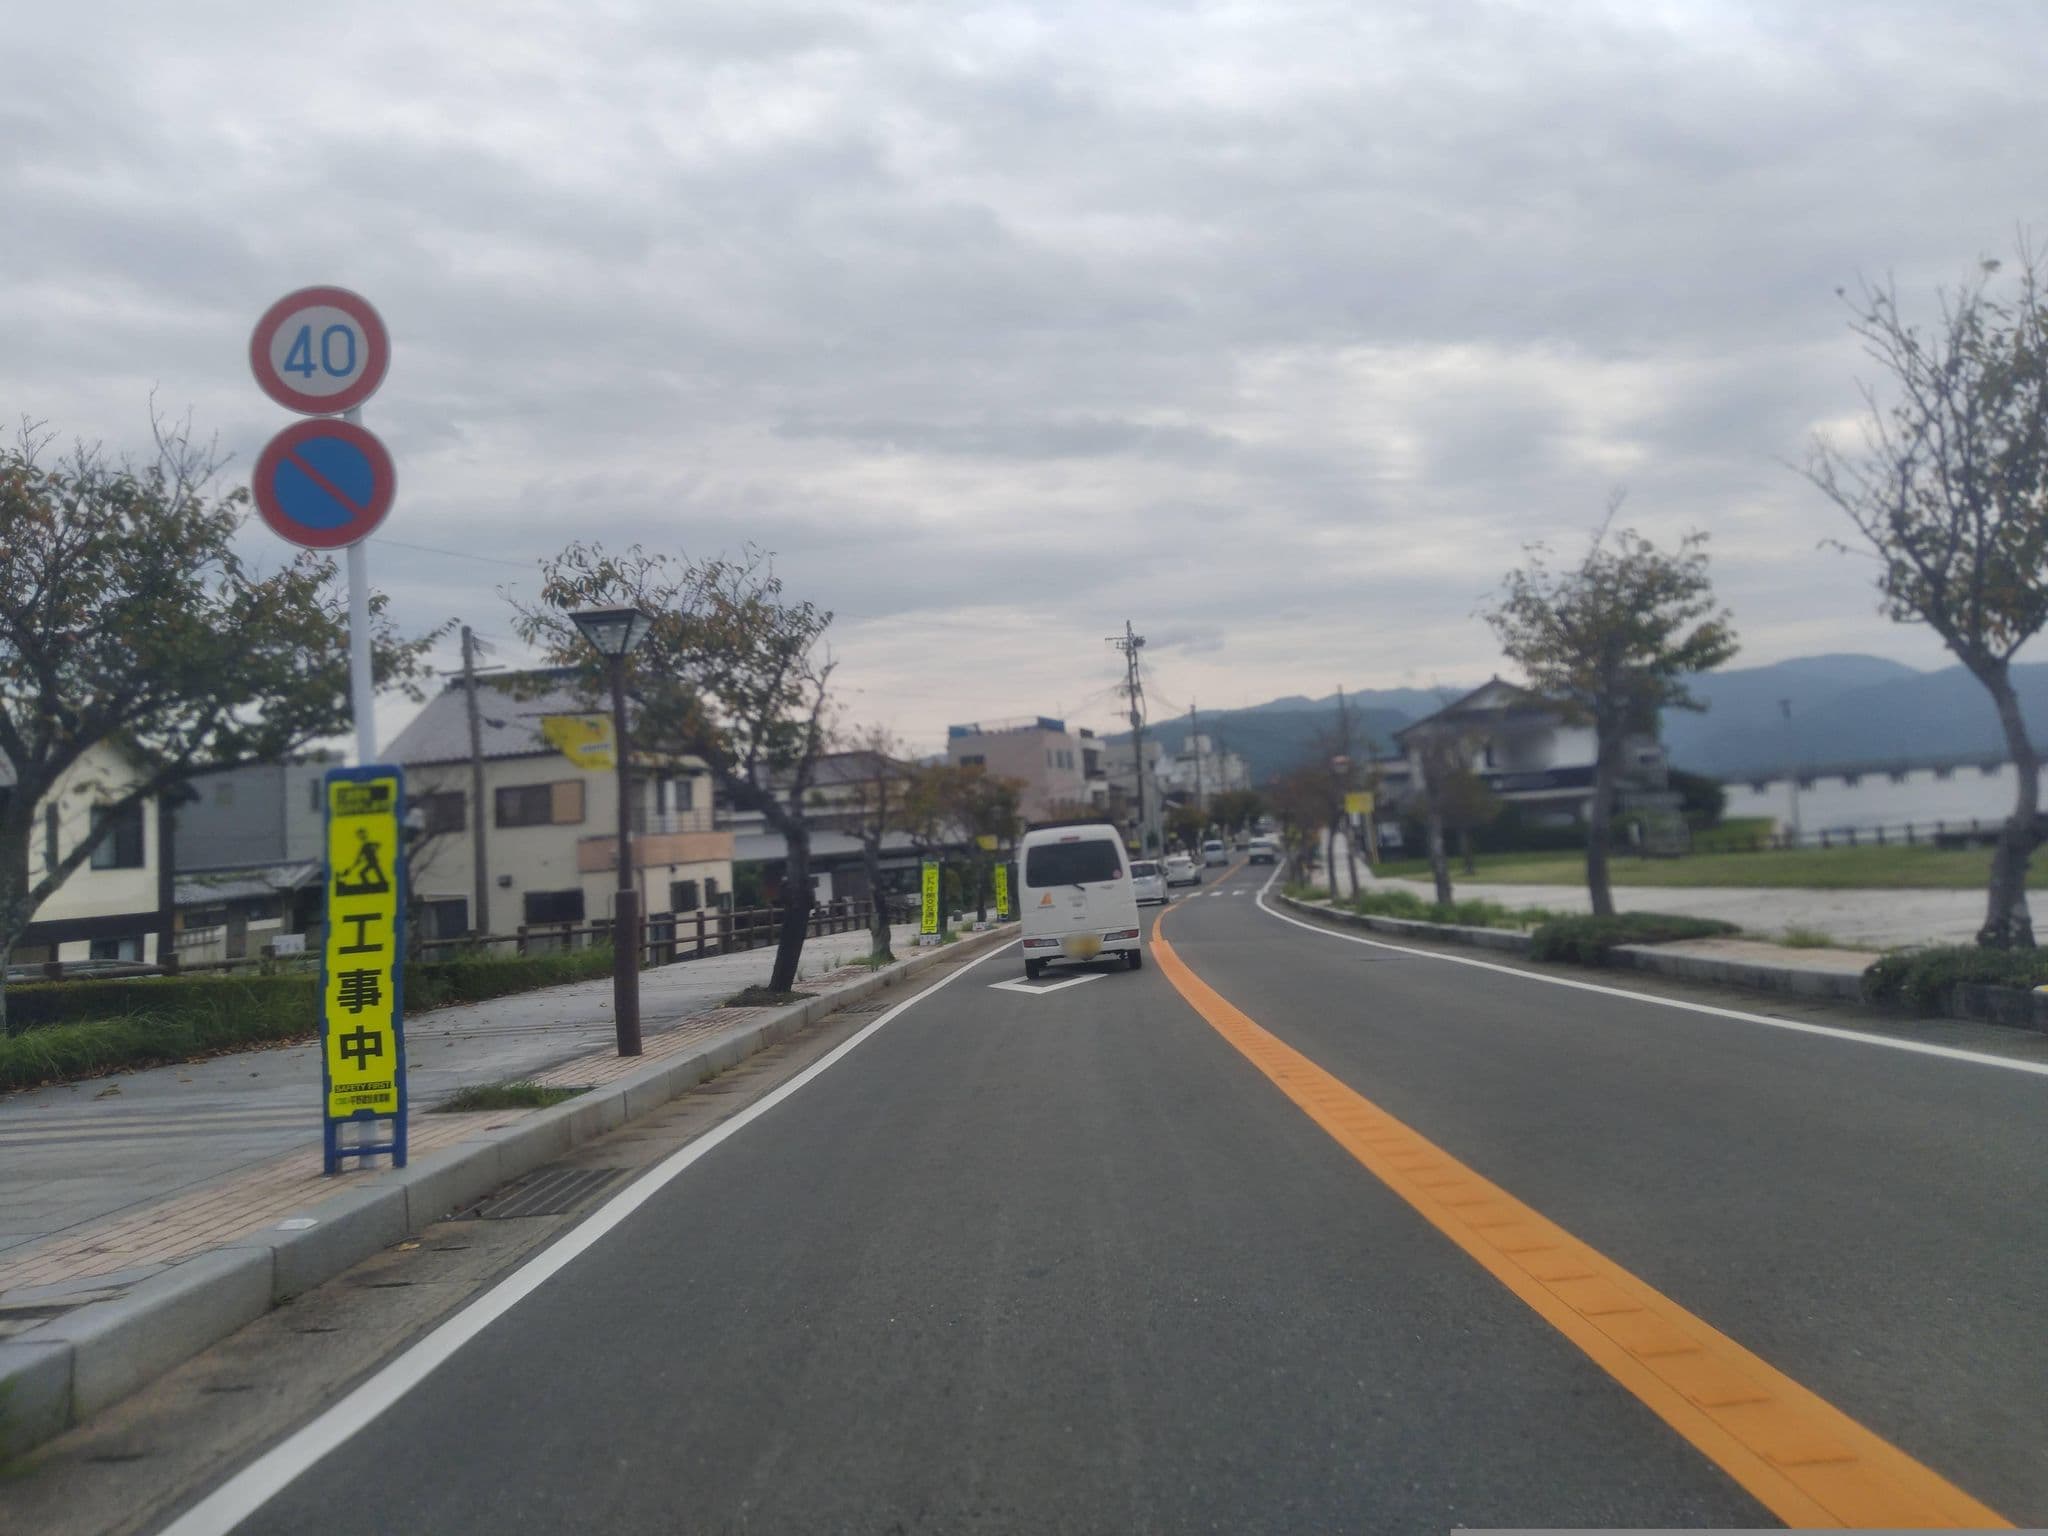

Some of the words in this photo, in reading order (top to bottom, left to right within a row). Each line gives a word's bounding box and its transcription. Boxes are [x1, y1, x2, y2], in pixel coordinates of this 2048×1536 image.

[283, 324, 356, 378] 40
[337, 912, 383, 1071] 工事中
